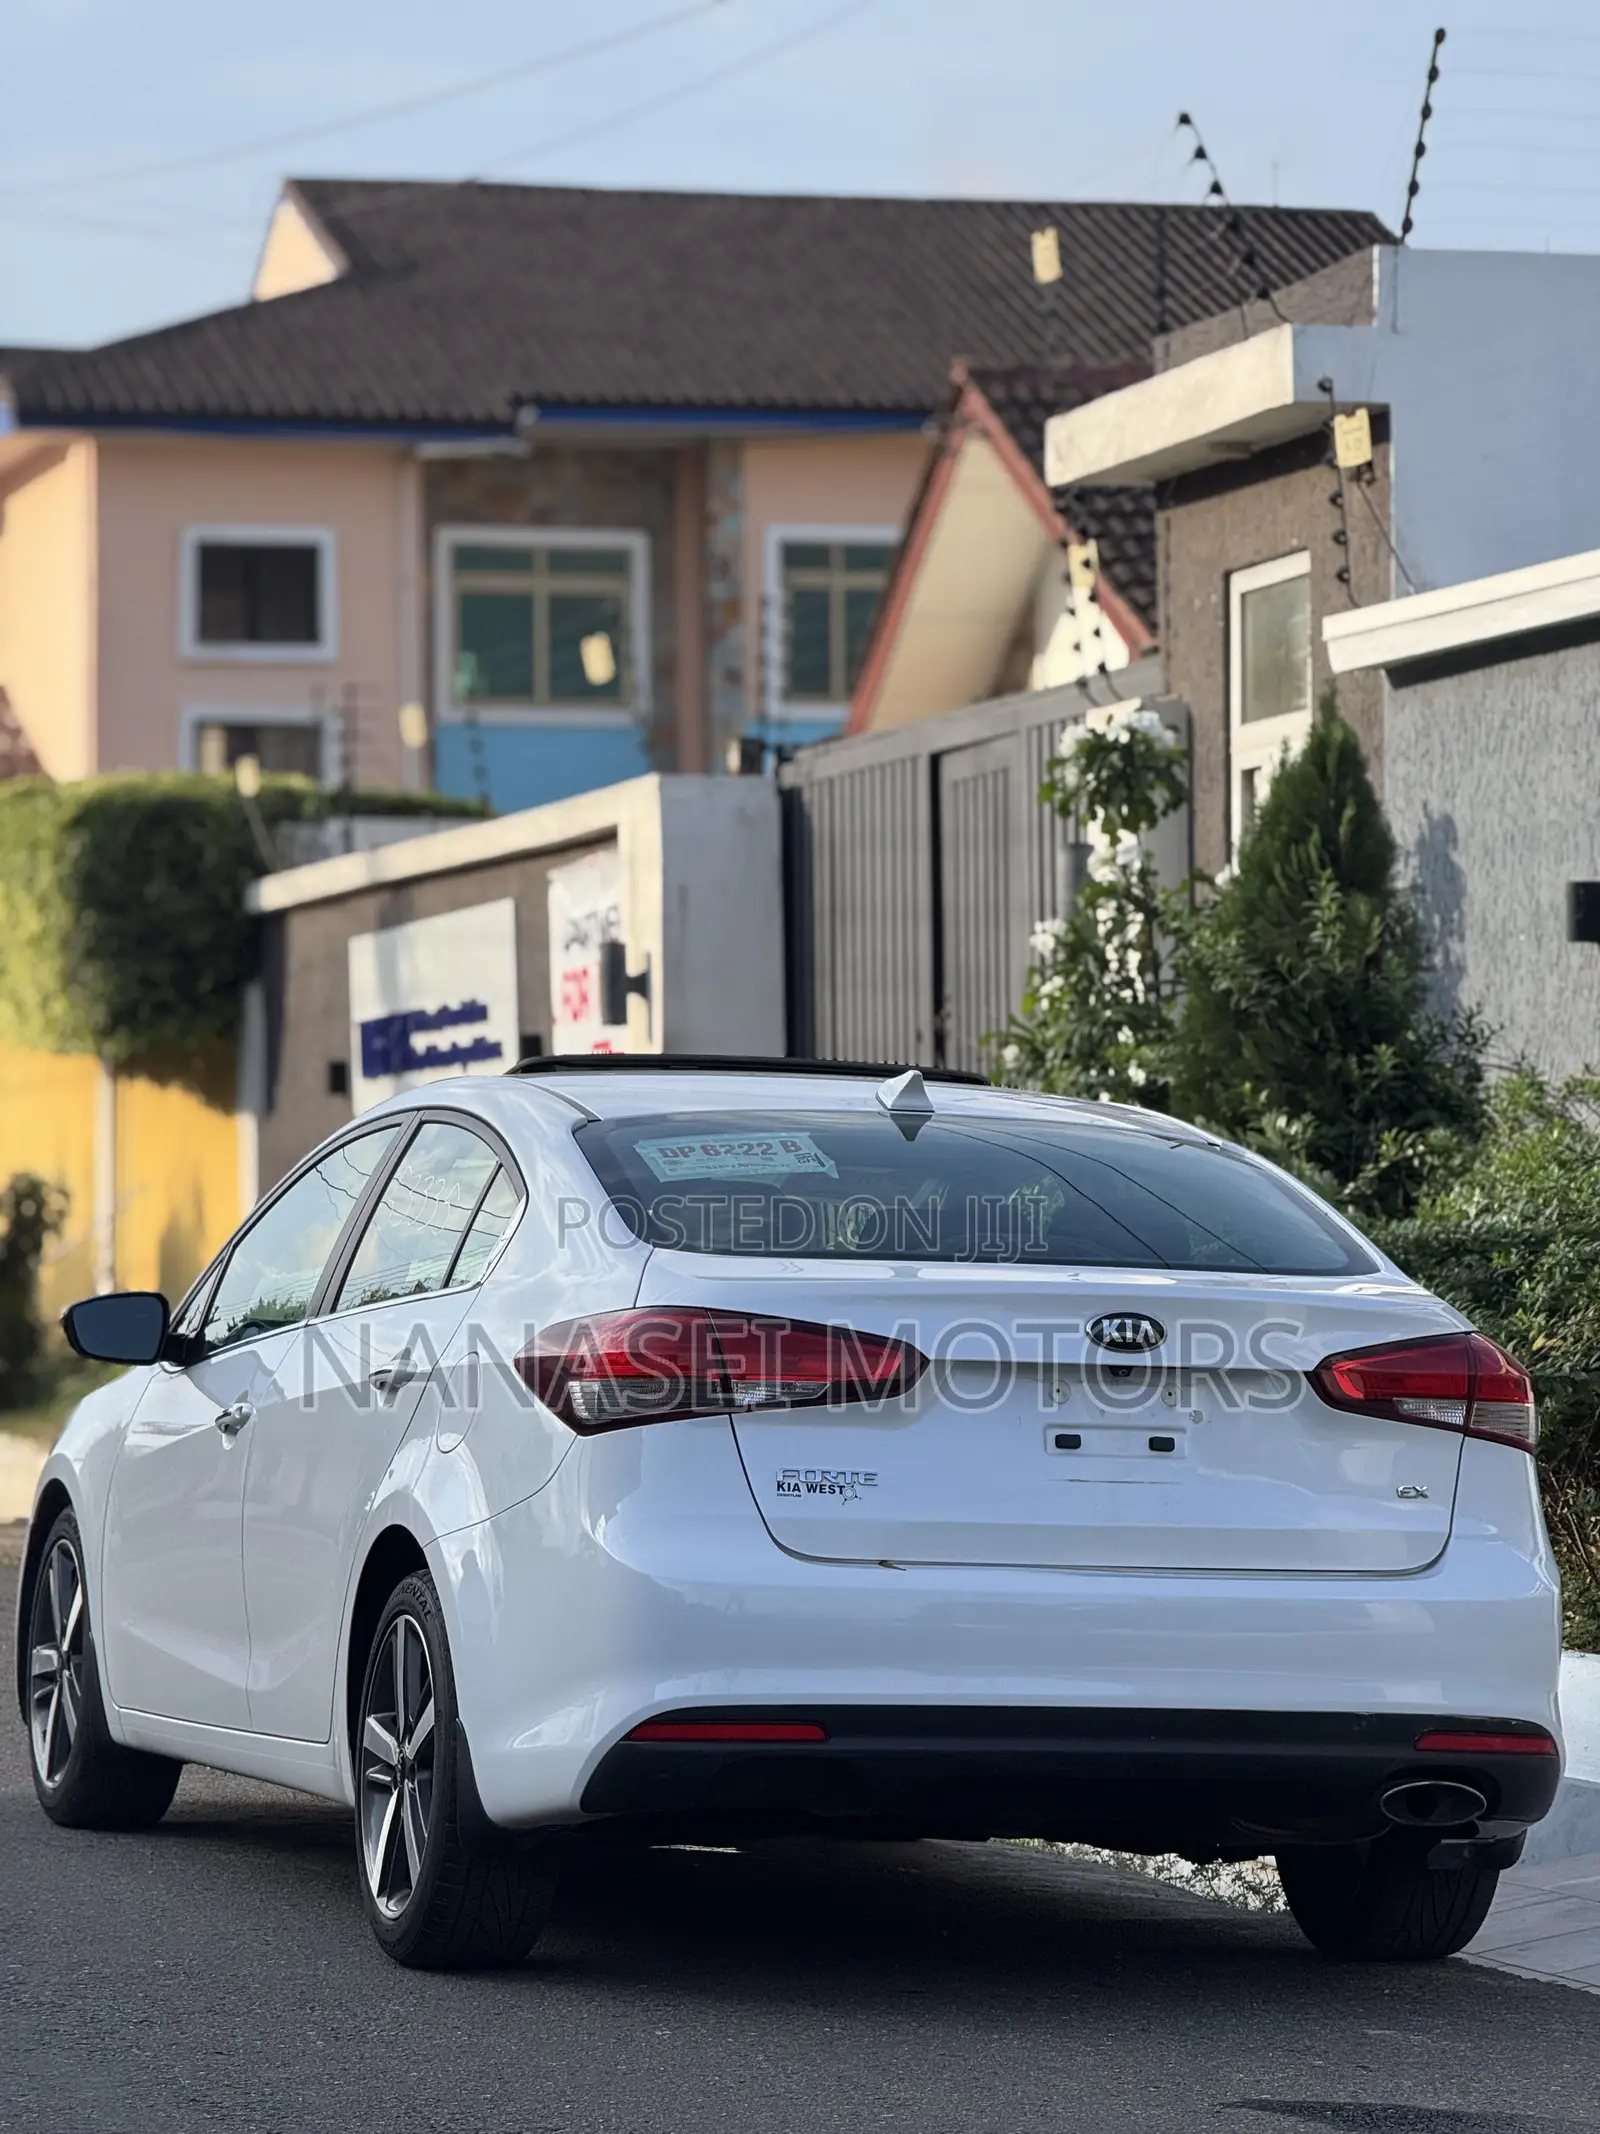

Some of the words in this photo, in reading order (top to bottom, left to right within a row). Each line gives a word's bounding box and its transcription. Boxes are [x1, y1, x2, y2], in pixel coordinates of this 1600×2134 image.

[657, 1146, 696, 1158] DP
[701, 1142, 777, 1157] 6222
[779, 1139, 802, 1153] B
[1101, 1318, 1156, 1343] KIA
[776, 1467, 879, 1487] FORTE
[776, 1481, 801, 1493] KIA
[806, 1483, 846, 1495] WEST
[1396, 1485, 1429, 1499] EX
